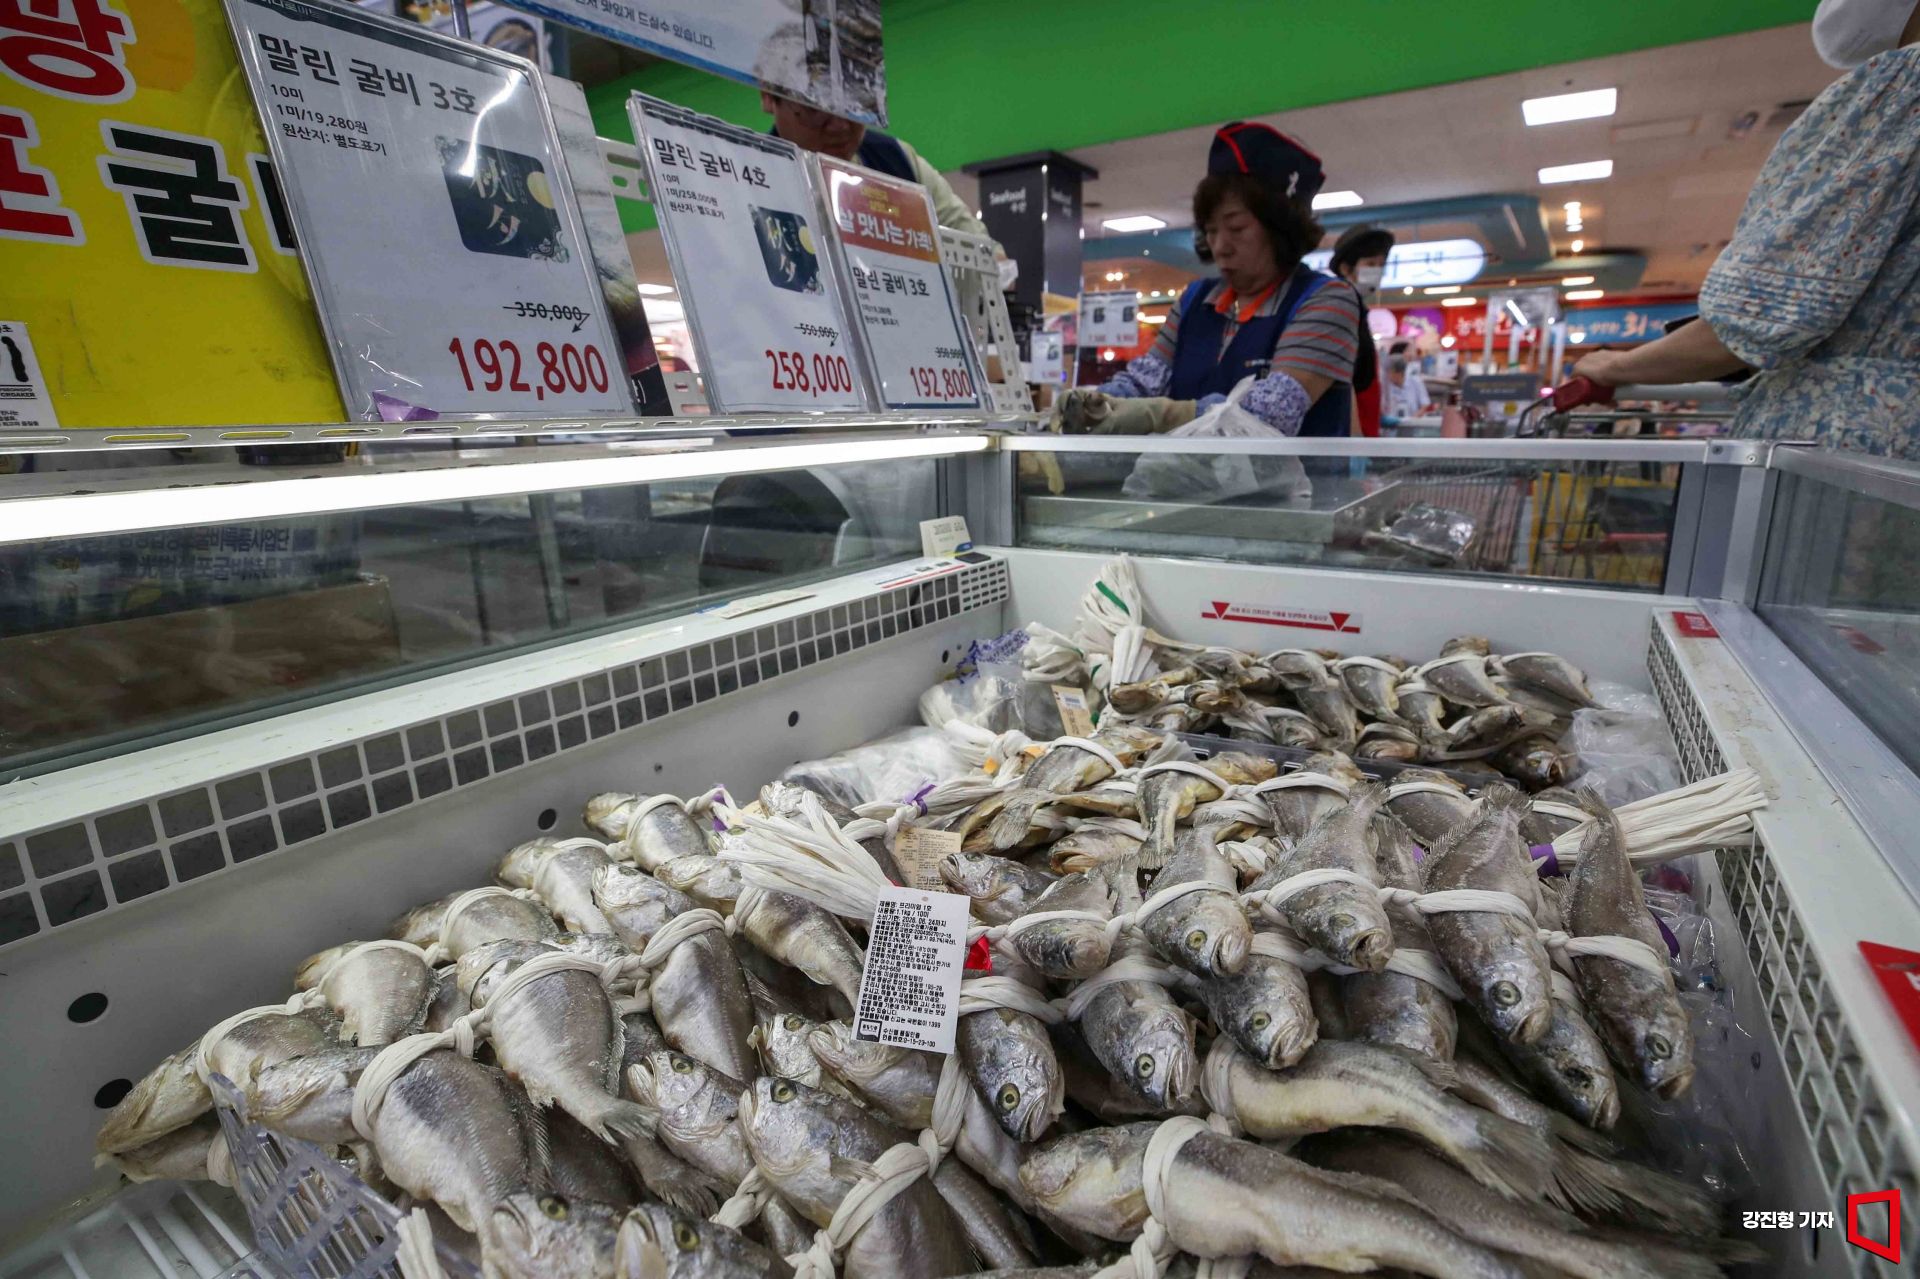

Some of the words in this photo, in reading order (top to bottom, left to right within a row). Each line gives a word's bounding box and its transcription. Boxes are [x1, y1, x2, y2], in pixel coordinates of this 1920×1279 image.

[601, 1, 637, 23] 맛있게
[638, 12, 670, 33] 드실수
[673, 24, 715, 50] 있습니다.
[258, 33, 340, 86] 말린
[349, 58, 420, 107] 굴비
[429, 81, 479, 115] 3호
[270, 84, 304, 102] 10미
[282, 122, 330, 143] 원산지:
[333, 133, 387, 156] 별도표기
[654, 137, 697, 172] 말린
[699, 150, 739, 183] 굴비
[742, 165, 770, 189] 4호
[661, 173, 680, 185] 10미
[669, 201, 696, 213] 원산지:
[697, 205, 725, 220] 별도표기
[990, 187, 1027, 206] Seafood
[857, 211, 905, 246] 맛나는
[853, 266, 881, 291] 말린
[882, 272, 908, 296] 굴비
[909, 279, 930, 296] 3호
[514, 301, 583, 321] 350,000
[800, 322, 836, 338] 550,000
[448, 336, 609, 401] 192,800
[765, 350, 852, 398] 258,000
[910, 366, 972, 401] 192,800
